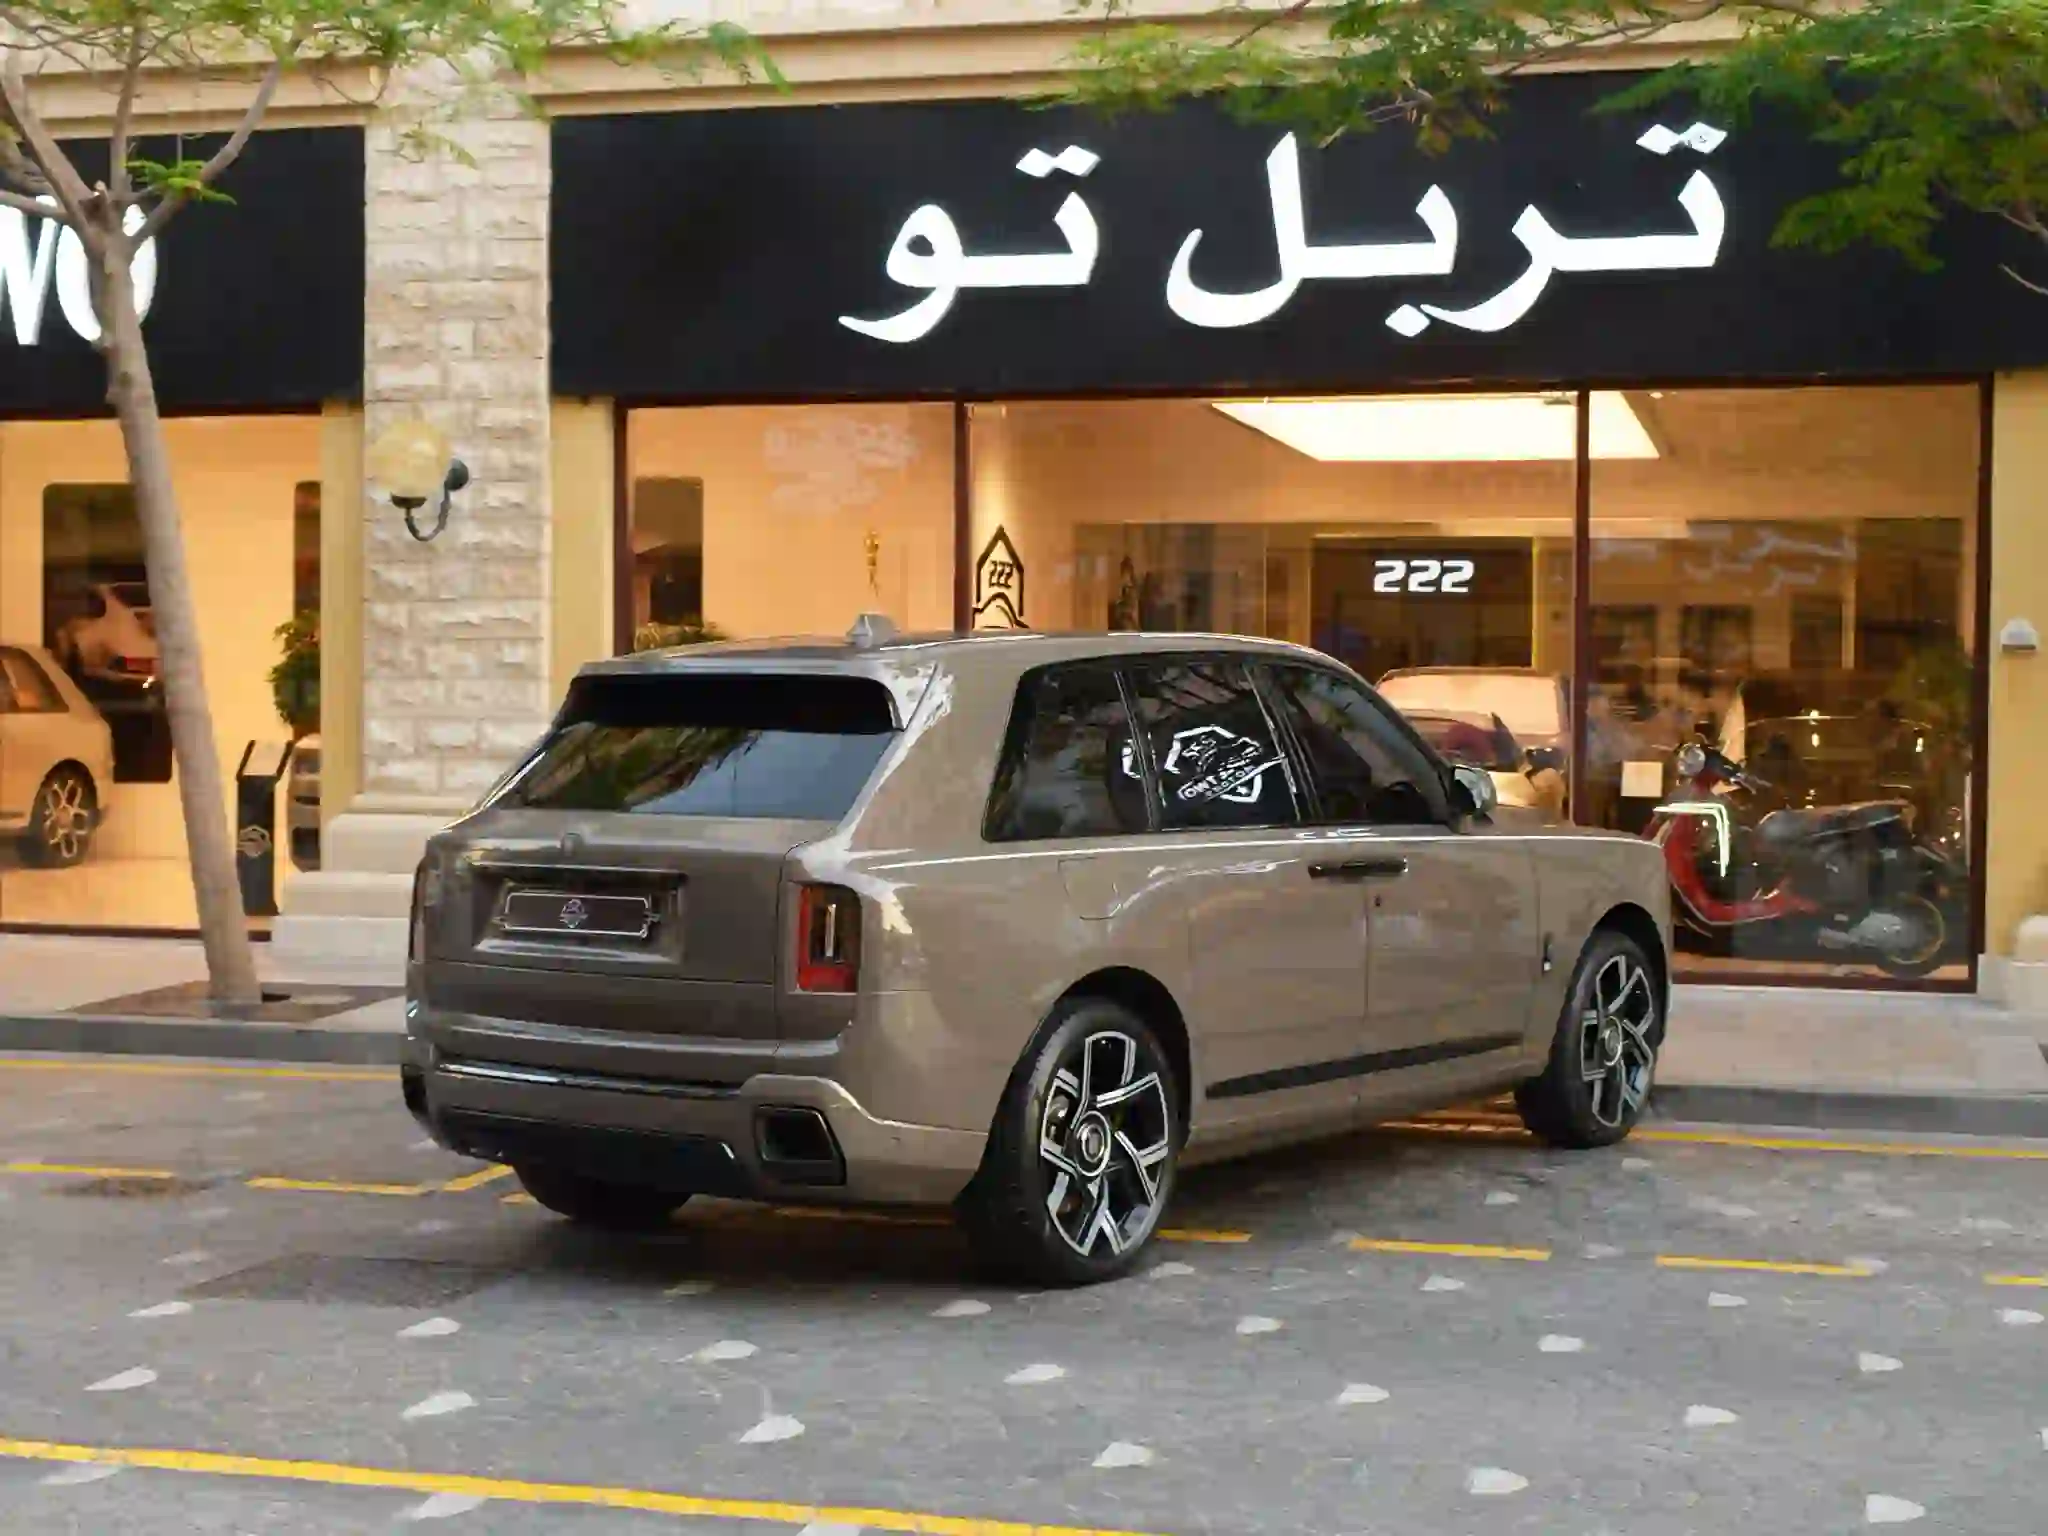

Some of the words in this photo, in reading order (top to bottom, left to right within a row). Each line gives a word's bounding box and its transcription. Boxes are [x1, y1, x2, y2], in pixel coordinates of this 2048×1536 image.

[838, 145, 1101, 343] تو
[1166, 121, 1728, 337] تربل
[1373, 560, 1474, 593] 222
